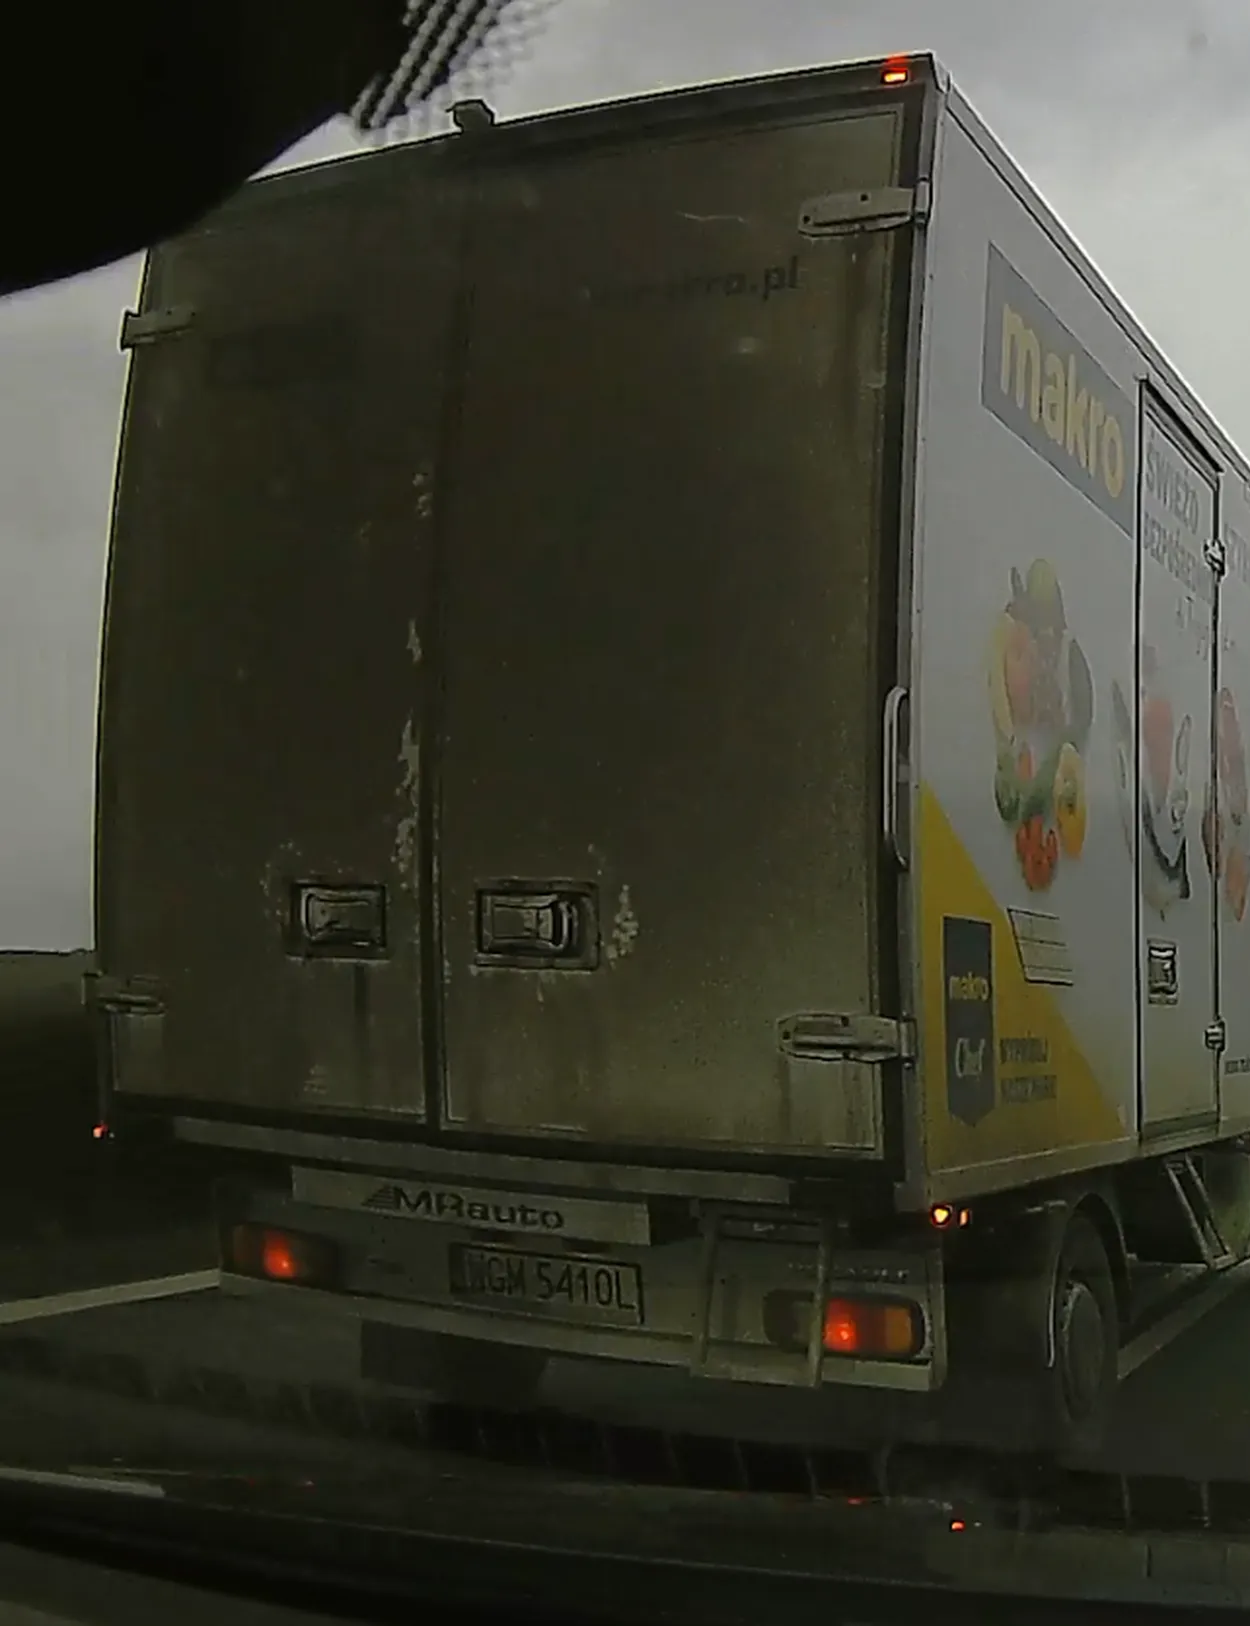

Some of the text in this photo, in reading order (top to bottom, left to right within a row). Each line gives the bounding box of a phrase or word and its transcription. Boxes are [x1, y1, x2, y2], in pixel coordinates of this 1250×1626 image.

[1000, 303, 1125, 498] makro
[391, 1185, 566, 1230] MRauto
[536, 1261, 637, 1311] 5410L
